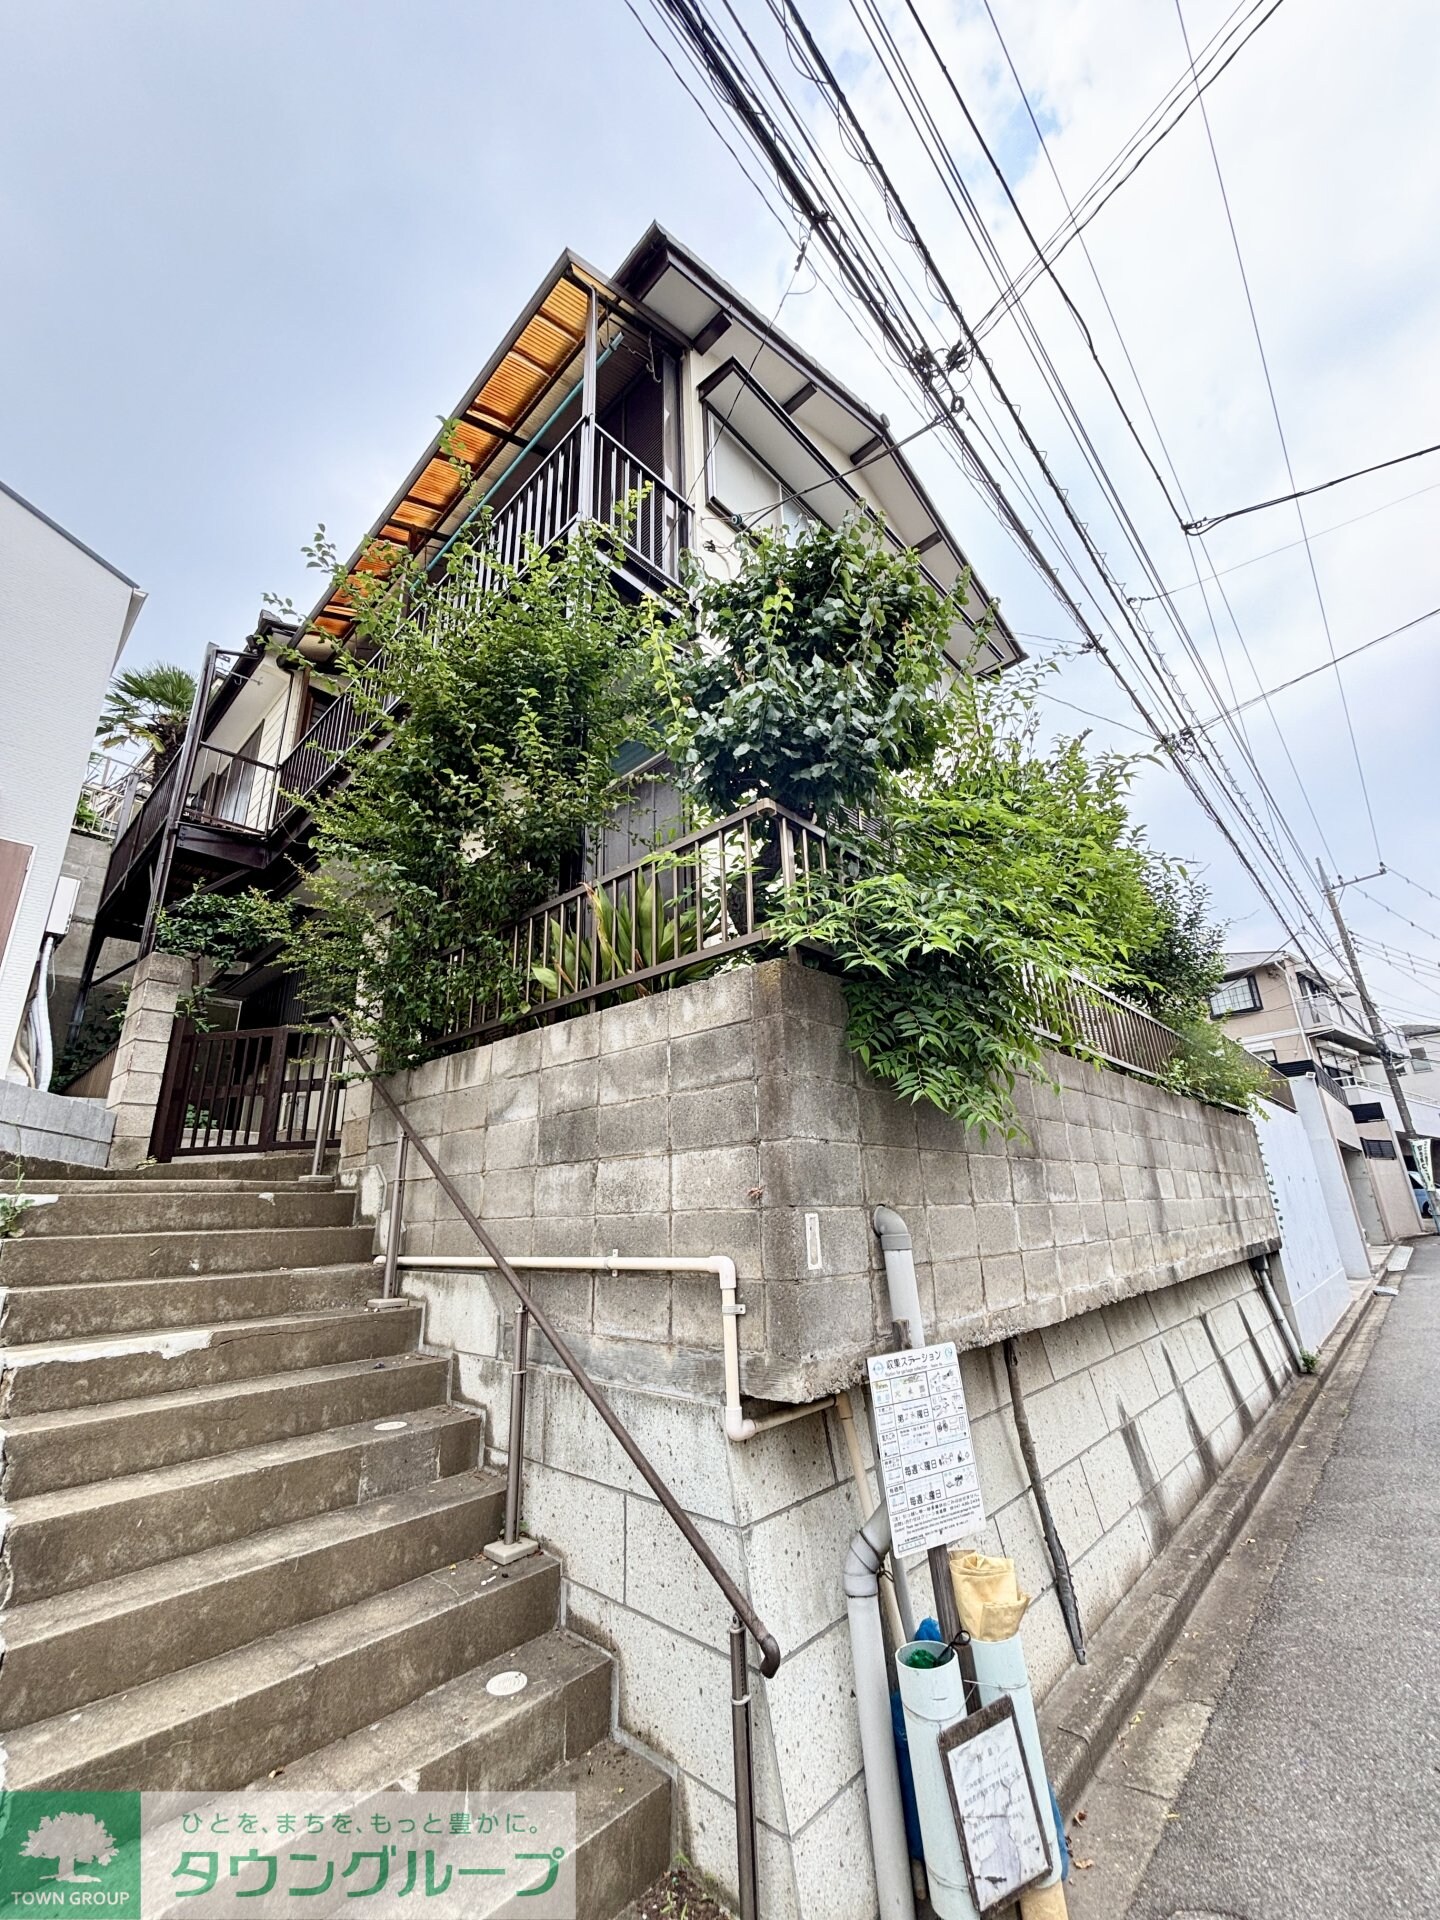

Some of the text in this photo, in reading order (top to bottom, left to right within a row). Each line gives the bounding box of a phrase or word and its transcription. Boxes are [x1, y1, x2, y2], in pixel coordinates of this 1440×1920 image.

[885, 1349, 942, 1370] 収集ステーション
